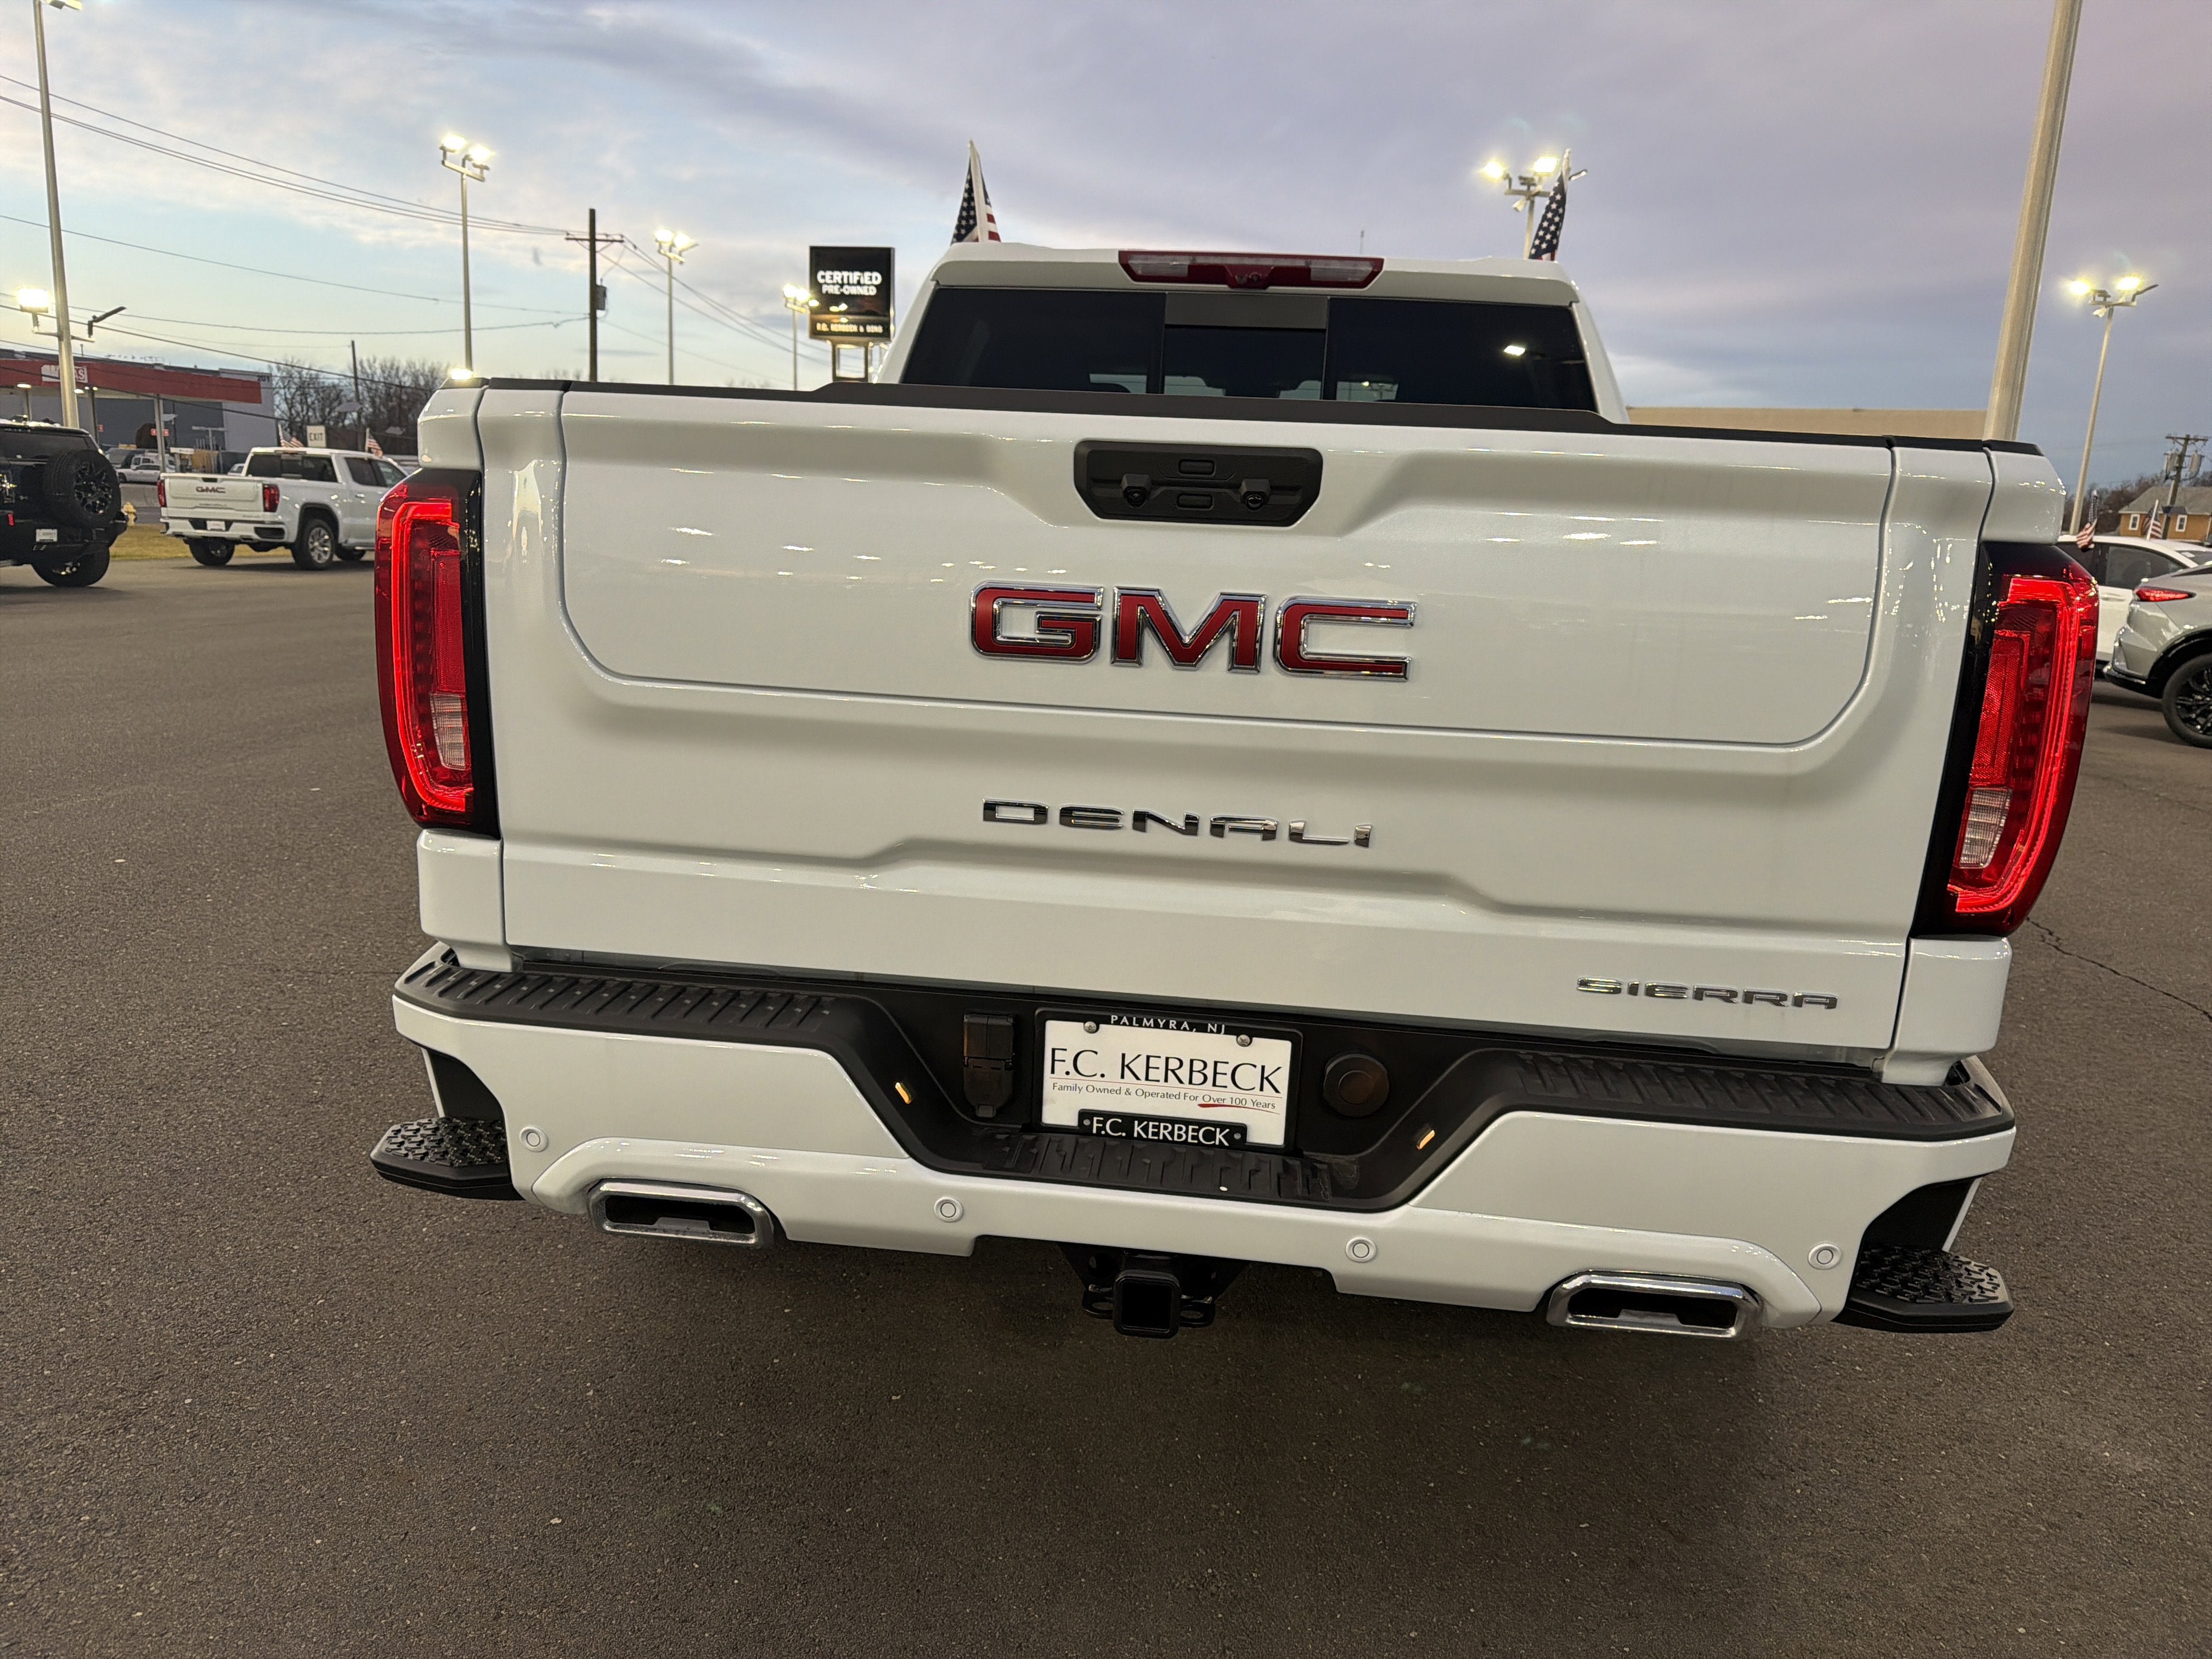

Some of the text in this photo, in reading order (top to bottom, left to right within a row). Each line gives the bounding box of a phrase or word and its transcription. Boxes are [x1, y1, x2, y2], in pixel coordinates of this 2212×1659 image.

[817, 270, 882, 285] CERTIFIED
[822, 285, 877, 296] PRE-OWNED
[970, 579, 1418, 681] GMC
[983, 798, 1372, 848] DENALI
[1577, 977, 1839, 1009] SIERRA
[1110, 1014, 1227, 1036] PALMYRA, NJ
[1050, 1047, 1283, 1094] F.C. KERBECK
[1052, 1082, 1276, 1109] Family Owned & Operated For Over 100 Years
[1092, 1117, 1231, 1147] F.C. KERBECK
